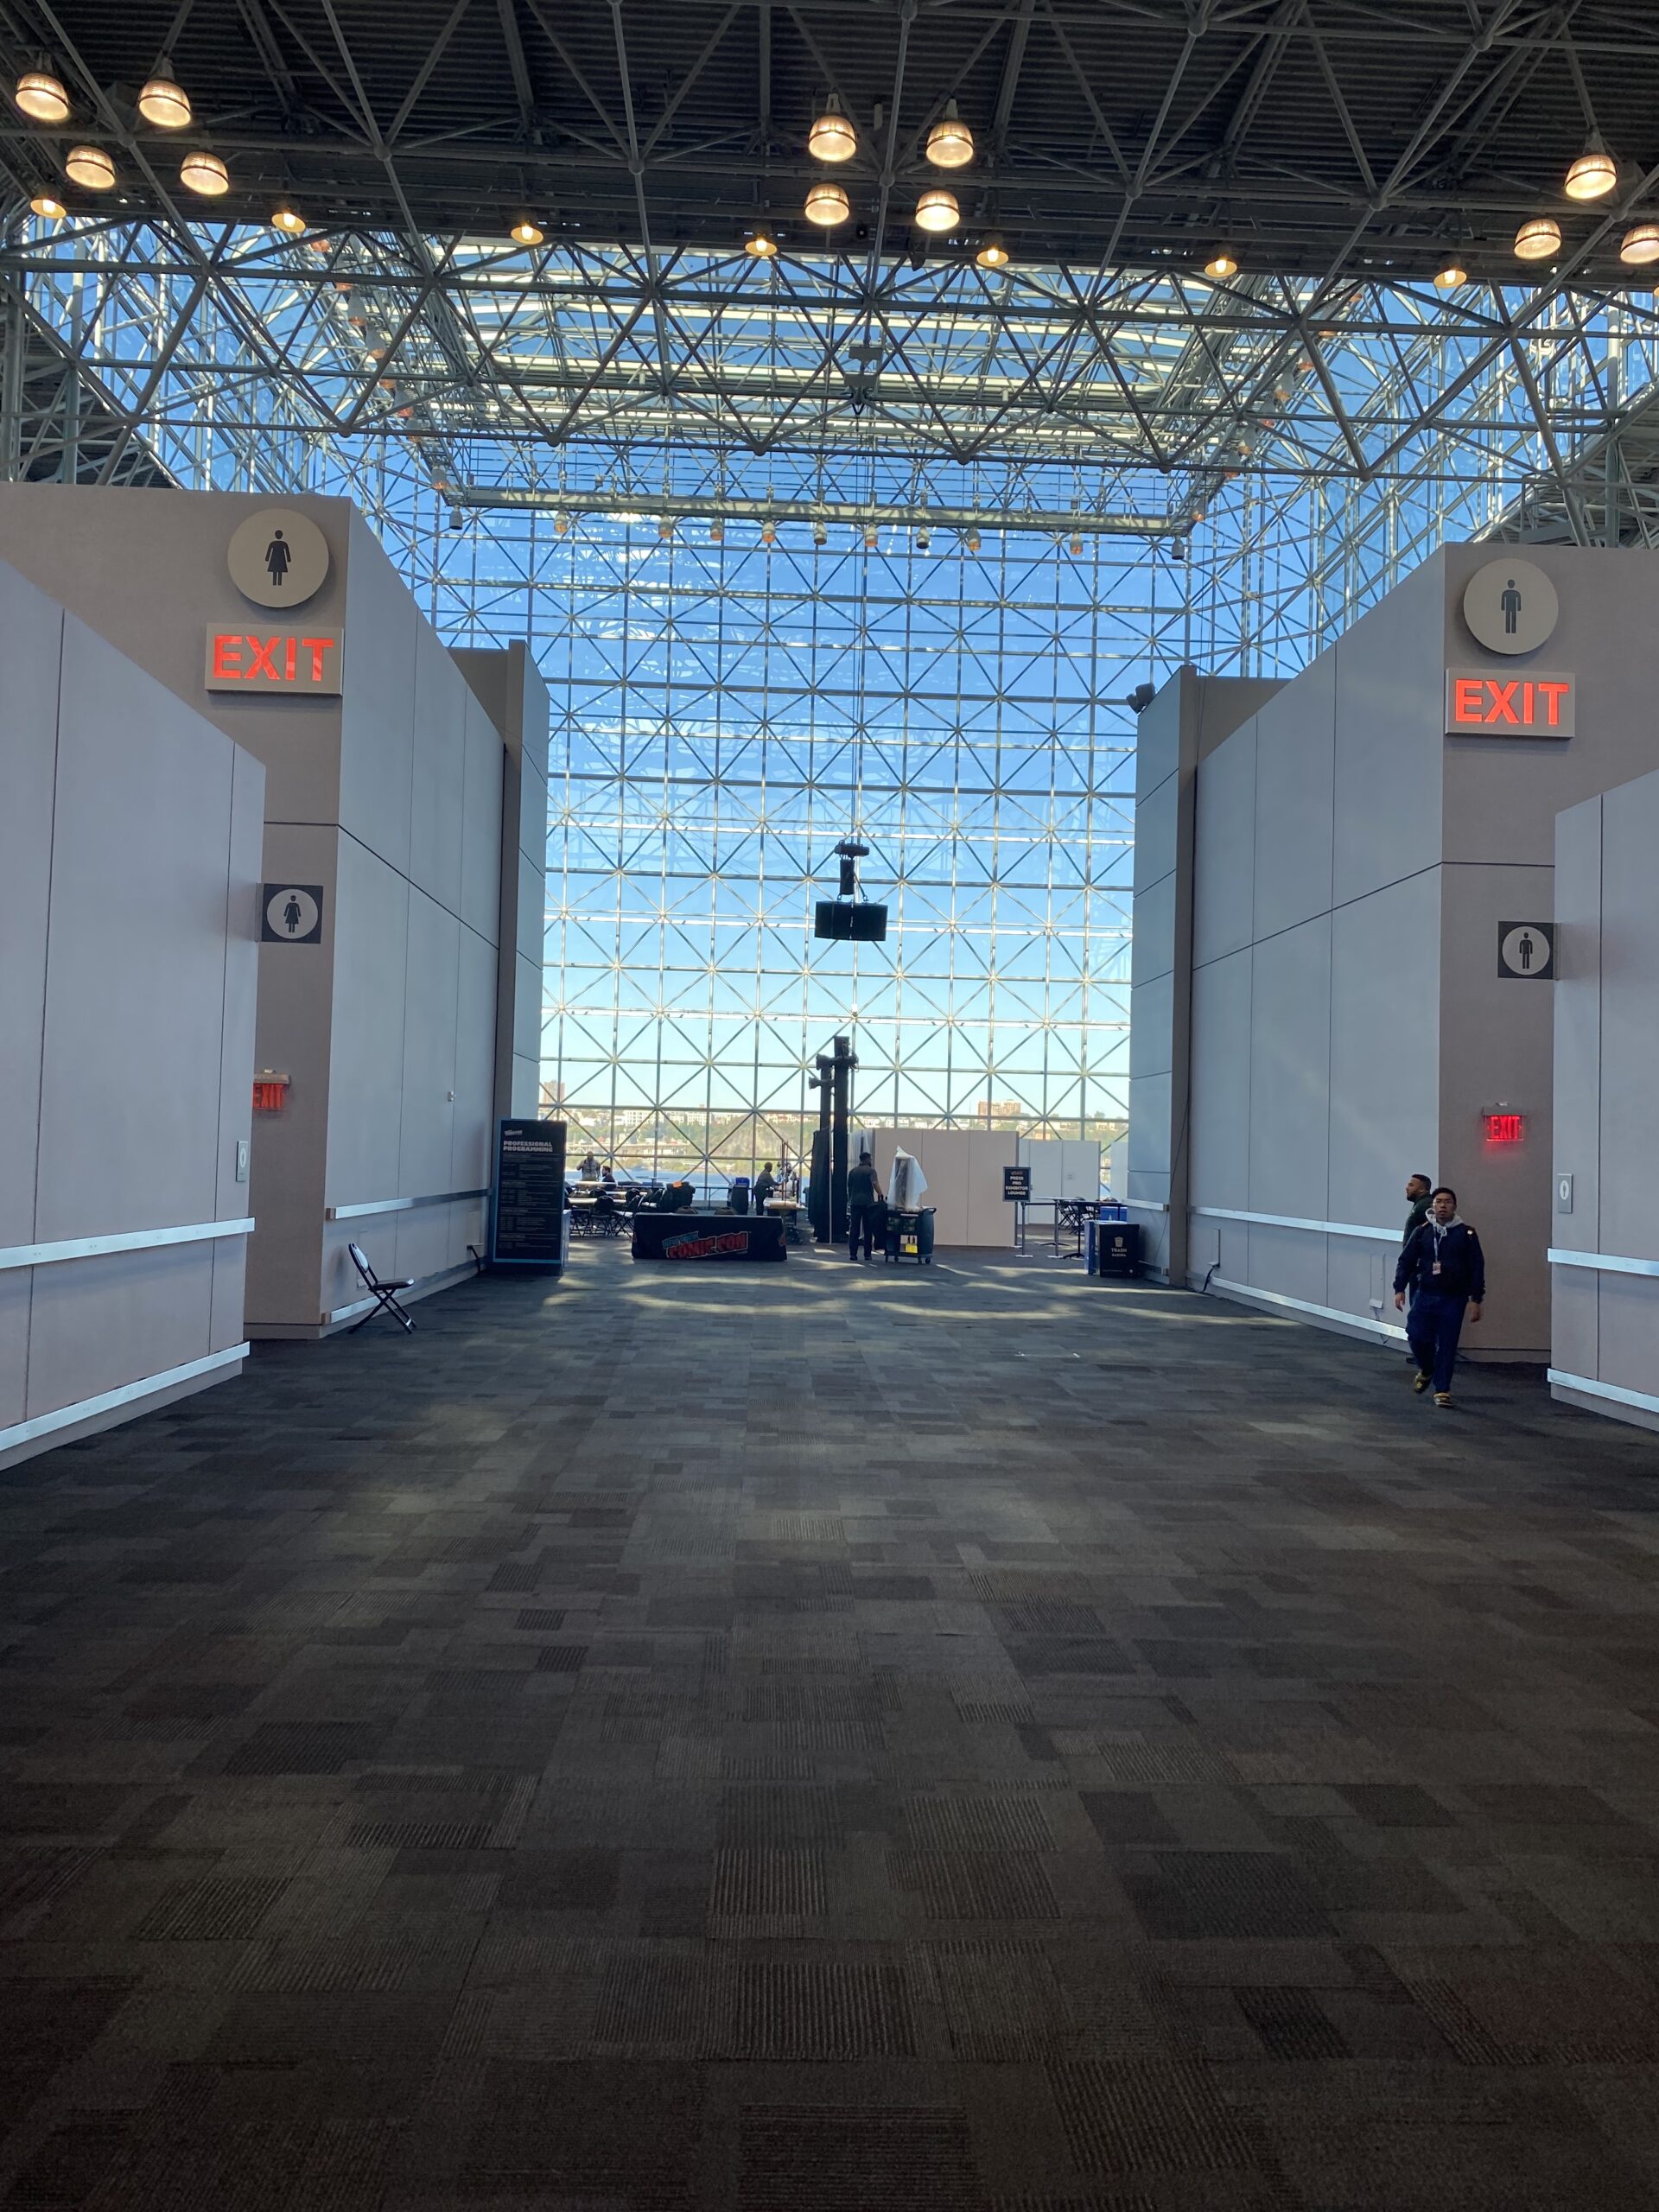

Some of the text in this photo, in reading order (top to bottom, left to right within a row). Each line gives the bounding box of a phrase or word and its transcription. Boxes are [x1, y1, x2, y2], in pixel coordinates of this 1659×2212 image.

[213, 633, 334, 682] EXIT
[1455, 678, 1570, 726] EXIT
[1491, 1116, 1520, 1139] EXIT
[668, 1233, 747, 1258] COMIC CON
